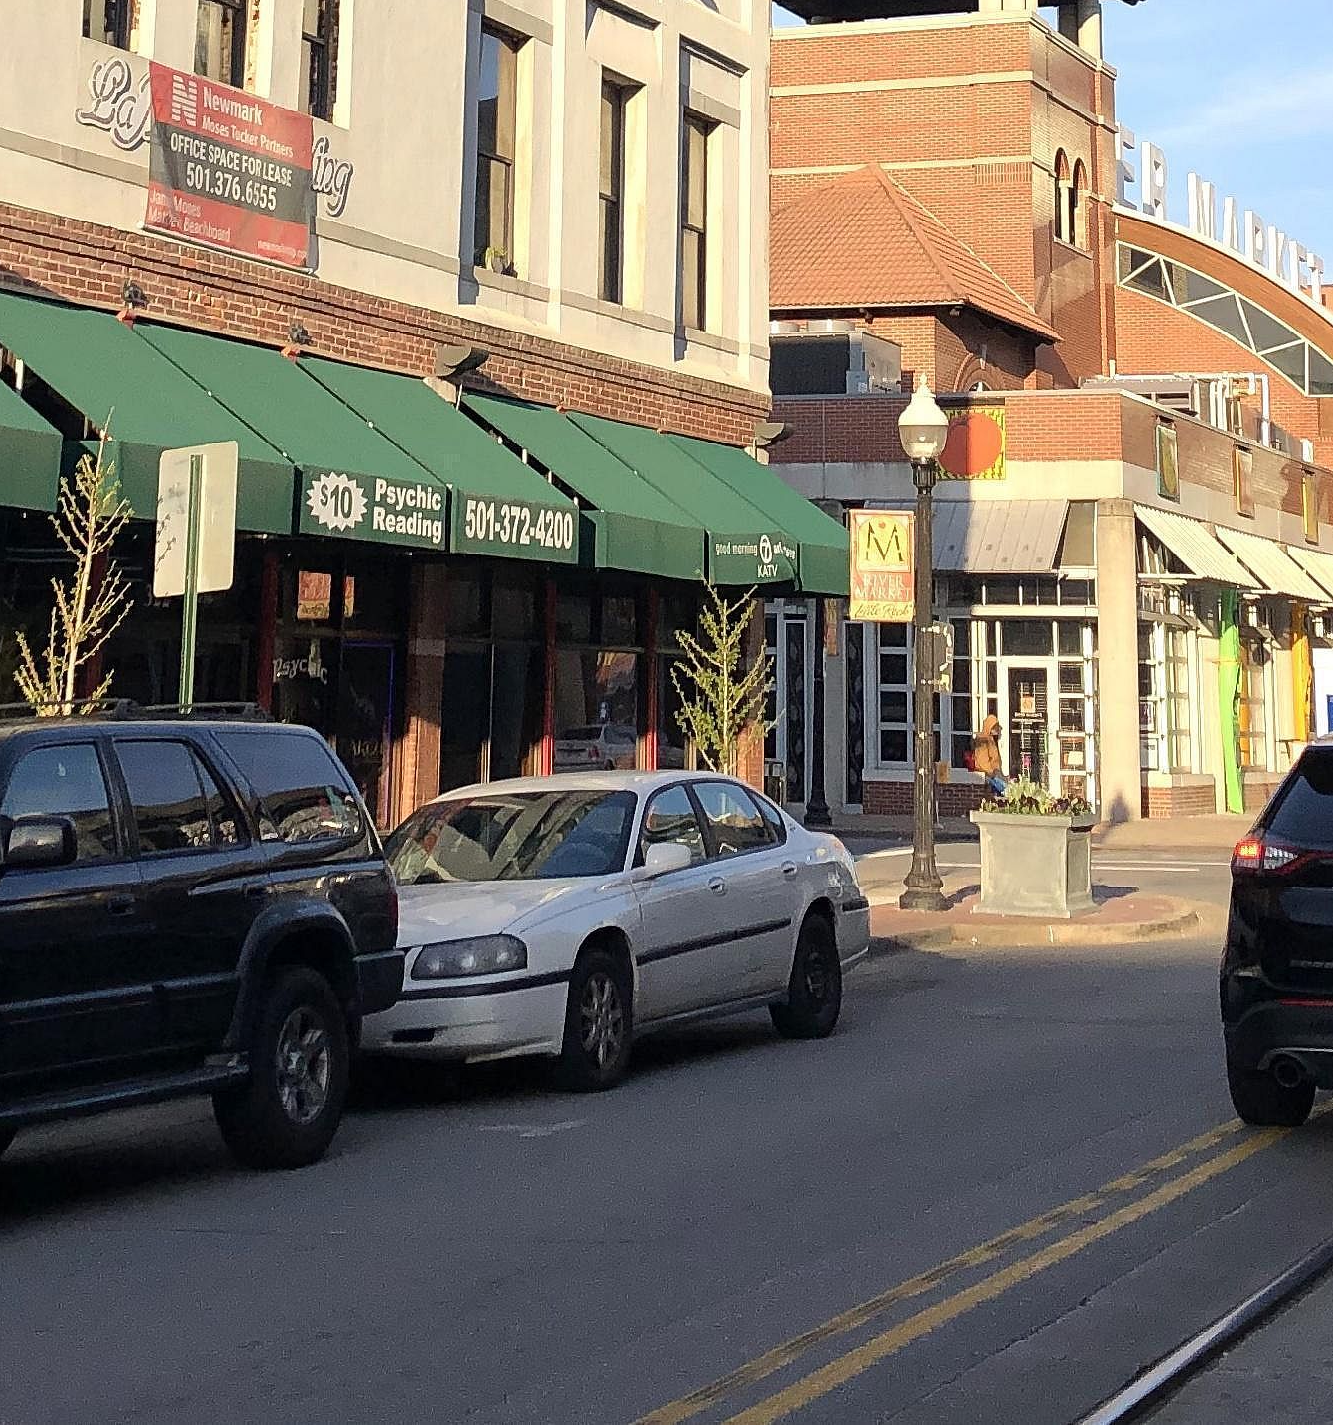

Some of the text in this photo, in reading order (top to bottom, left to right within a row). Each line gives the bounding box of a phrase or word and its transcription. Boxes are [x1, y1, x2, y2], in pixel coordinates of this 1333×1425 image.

[203, 87, 263, 125] Newmark
[202, 115, 294, 158] Moses Tucker Partners
[170, 133, 292, 187] OFFICE SPACE FOR LEASE
[186, 162, 277, 211] 501.376.6555
[1187, 171, 1324, 309] MARKET
[320, 478, 442, 519] $10 Psychic
[373, 507, 442, 544] Reading
[465, 500, 573, 549] 501-372-4200
[867, 521, 904, 562] M
[715, 542, 731, 555] good
[732, 542, 758, 556] morning
[757, 564, 778, 578] KATV
[863, 574, 905, 588] RIVER
[854, 585, 911, 600] MARKET
